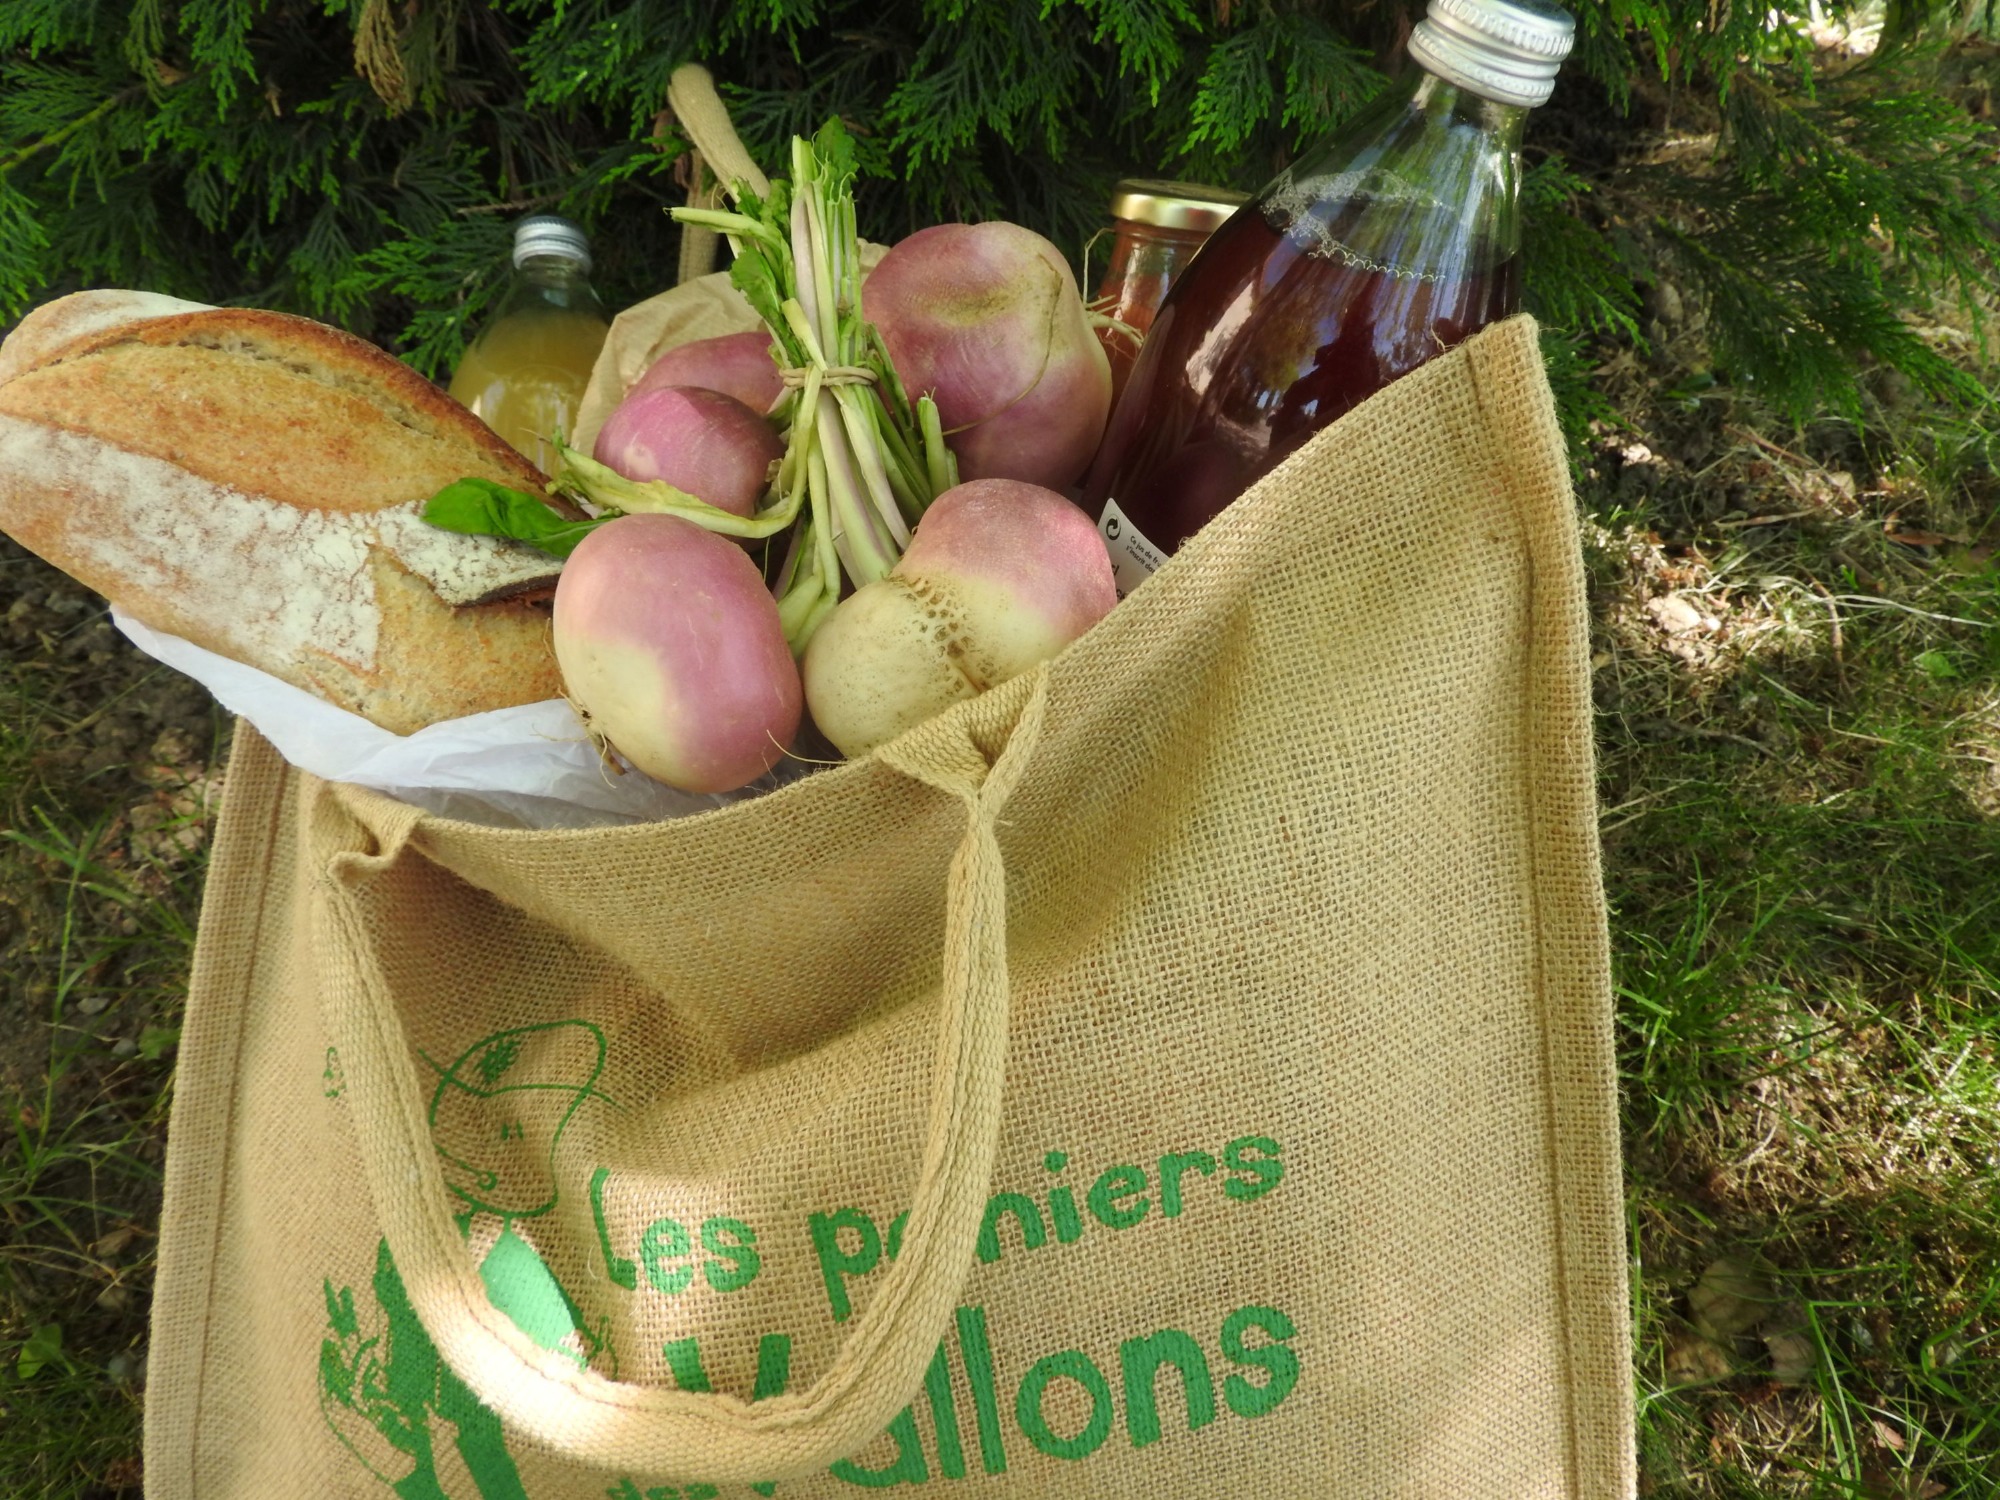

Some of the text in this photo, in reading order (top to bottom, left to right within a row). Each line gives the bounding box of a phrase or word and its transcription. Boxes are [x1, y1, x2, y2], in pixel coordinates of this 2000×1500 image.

[1144, 551, 1153, 560] de
[589, 1134, 1285, 1323] Les pniers
